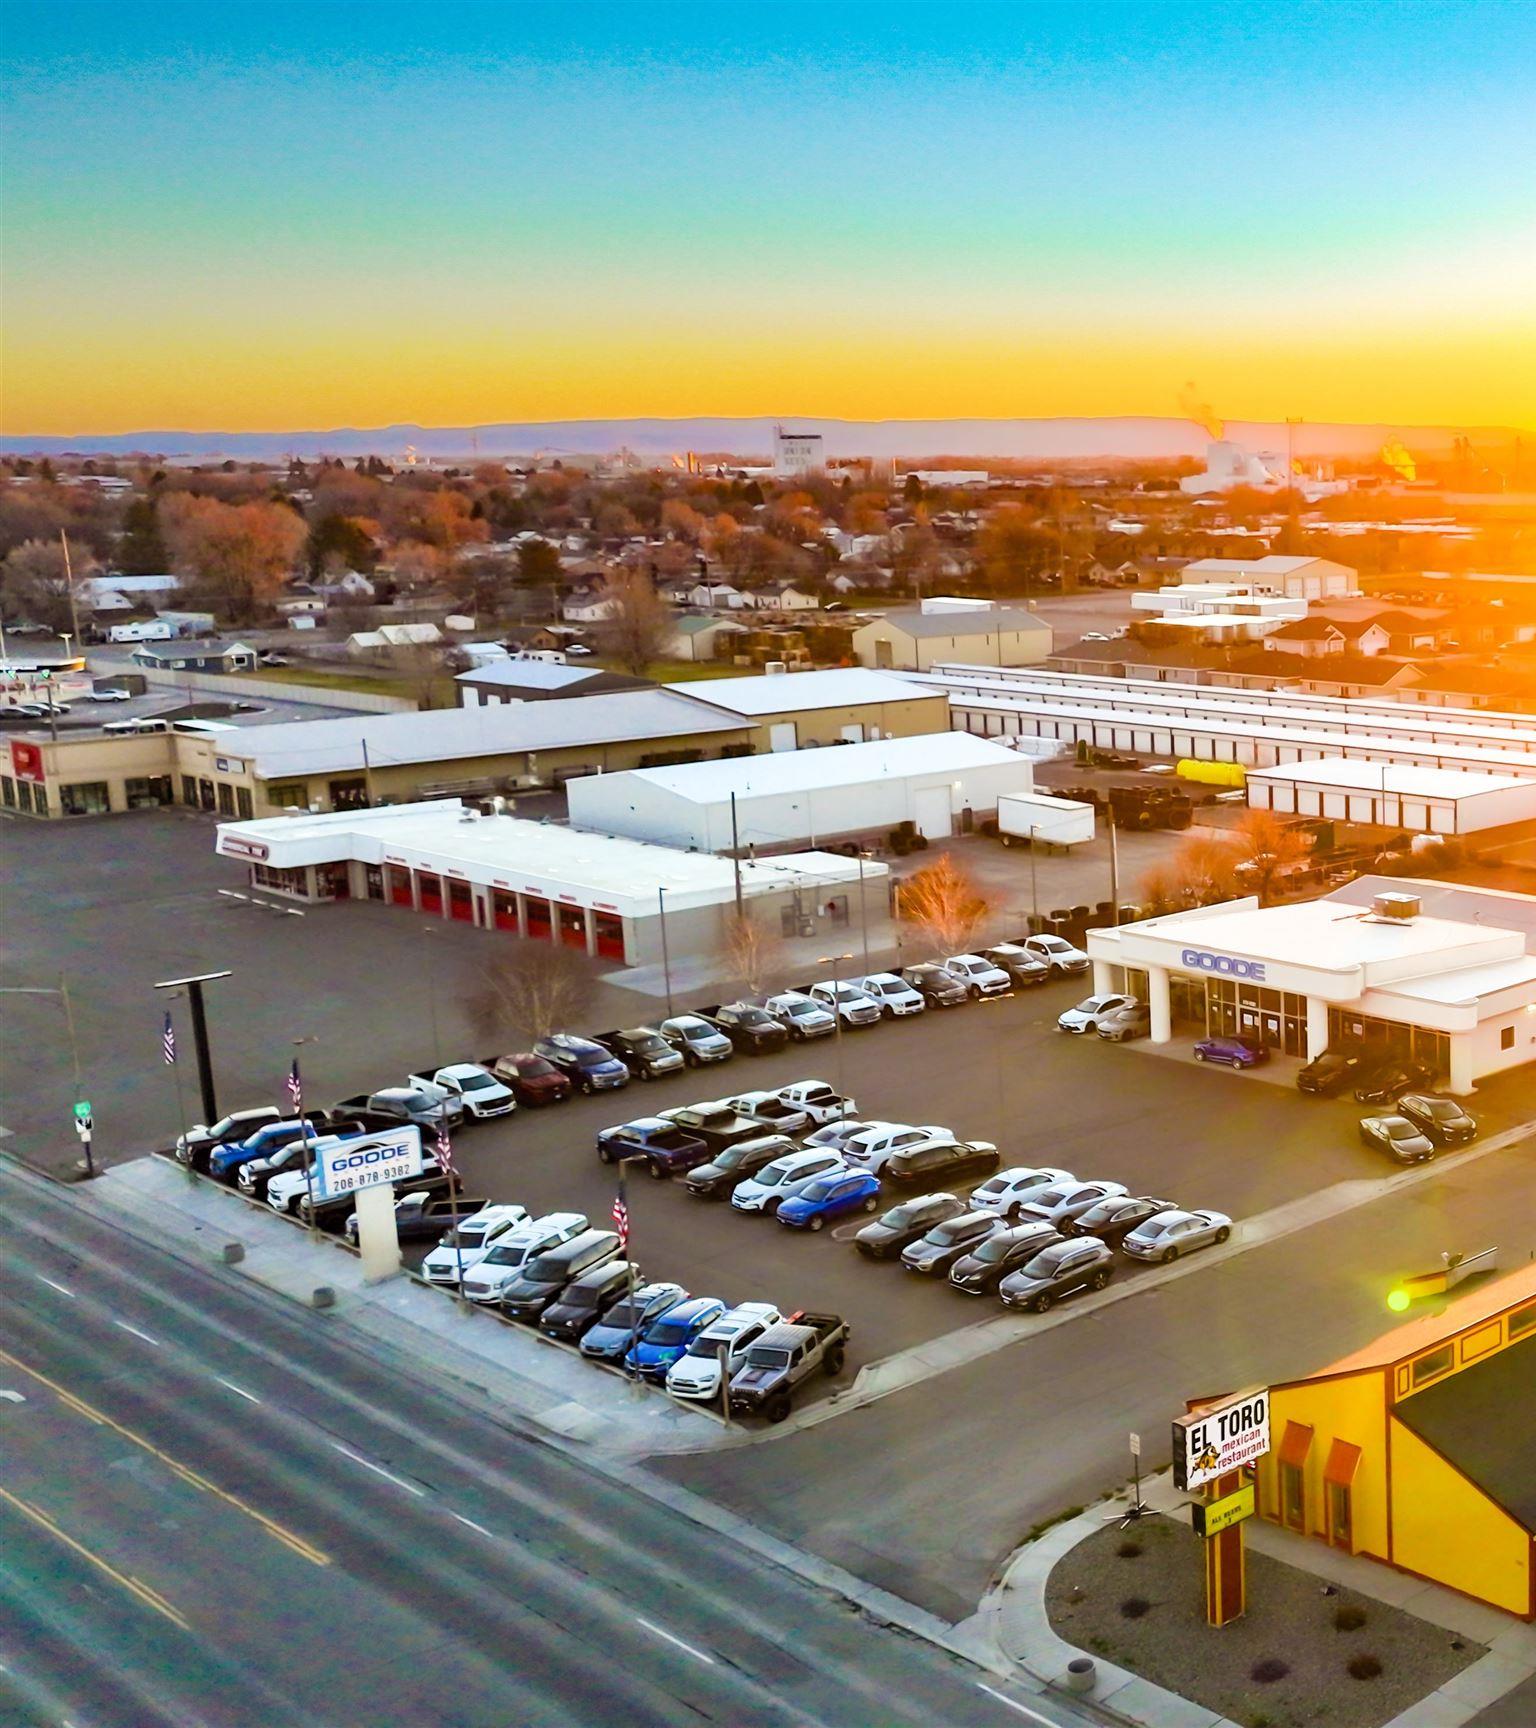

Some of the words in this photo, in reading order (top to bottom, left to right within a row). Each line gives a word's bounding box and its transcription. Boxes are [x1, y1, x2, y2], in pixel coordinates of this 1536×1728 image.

[1182, 949, 1266, 982] GOODE
[332, 1144, 410, 1172] GOODE
[1191, 1423, 1212, 1456] EL
[1217, 1398, 1265, 1442] TORO
[1221, 1428, 1261, 1454] mexican
[1216, 1438, 1266, 1470] restaurant
